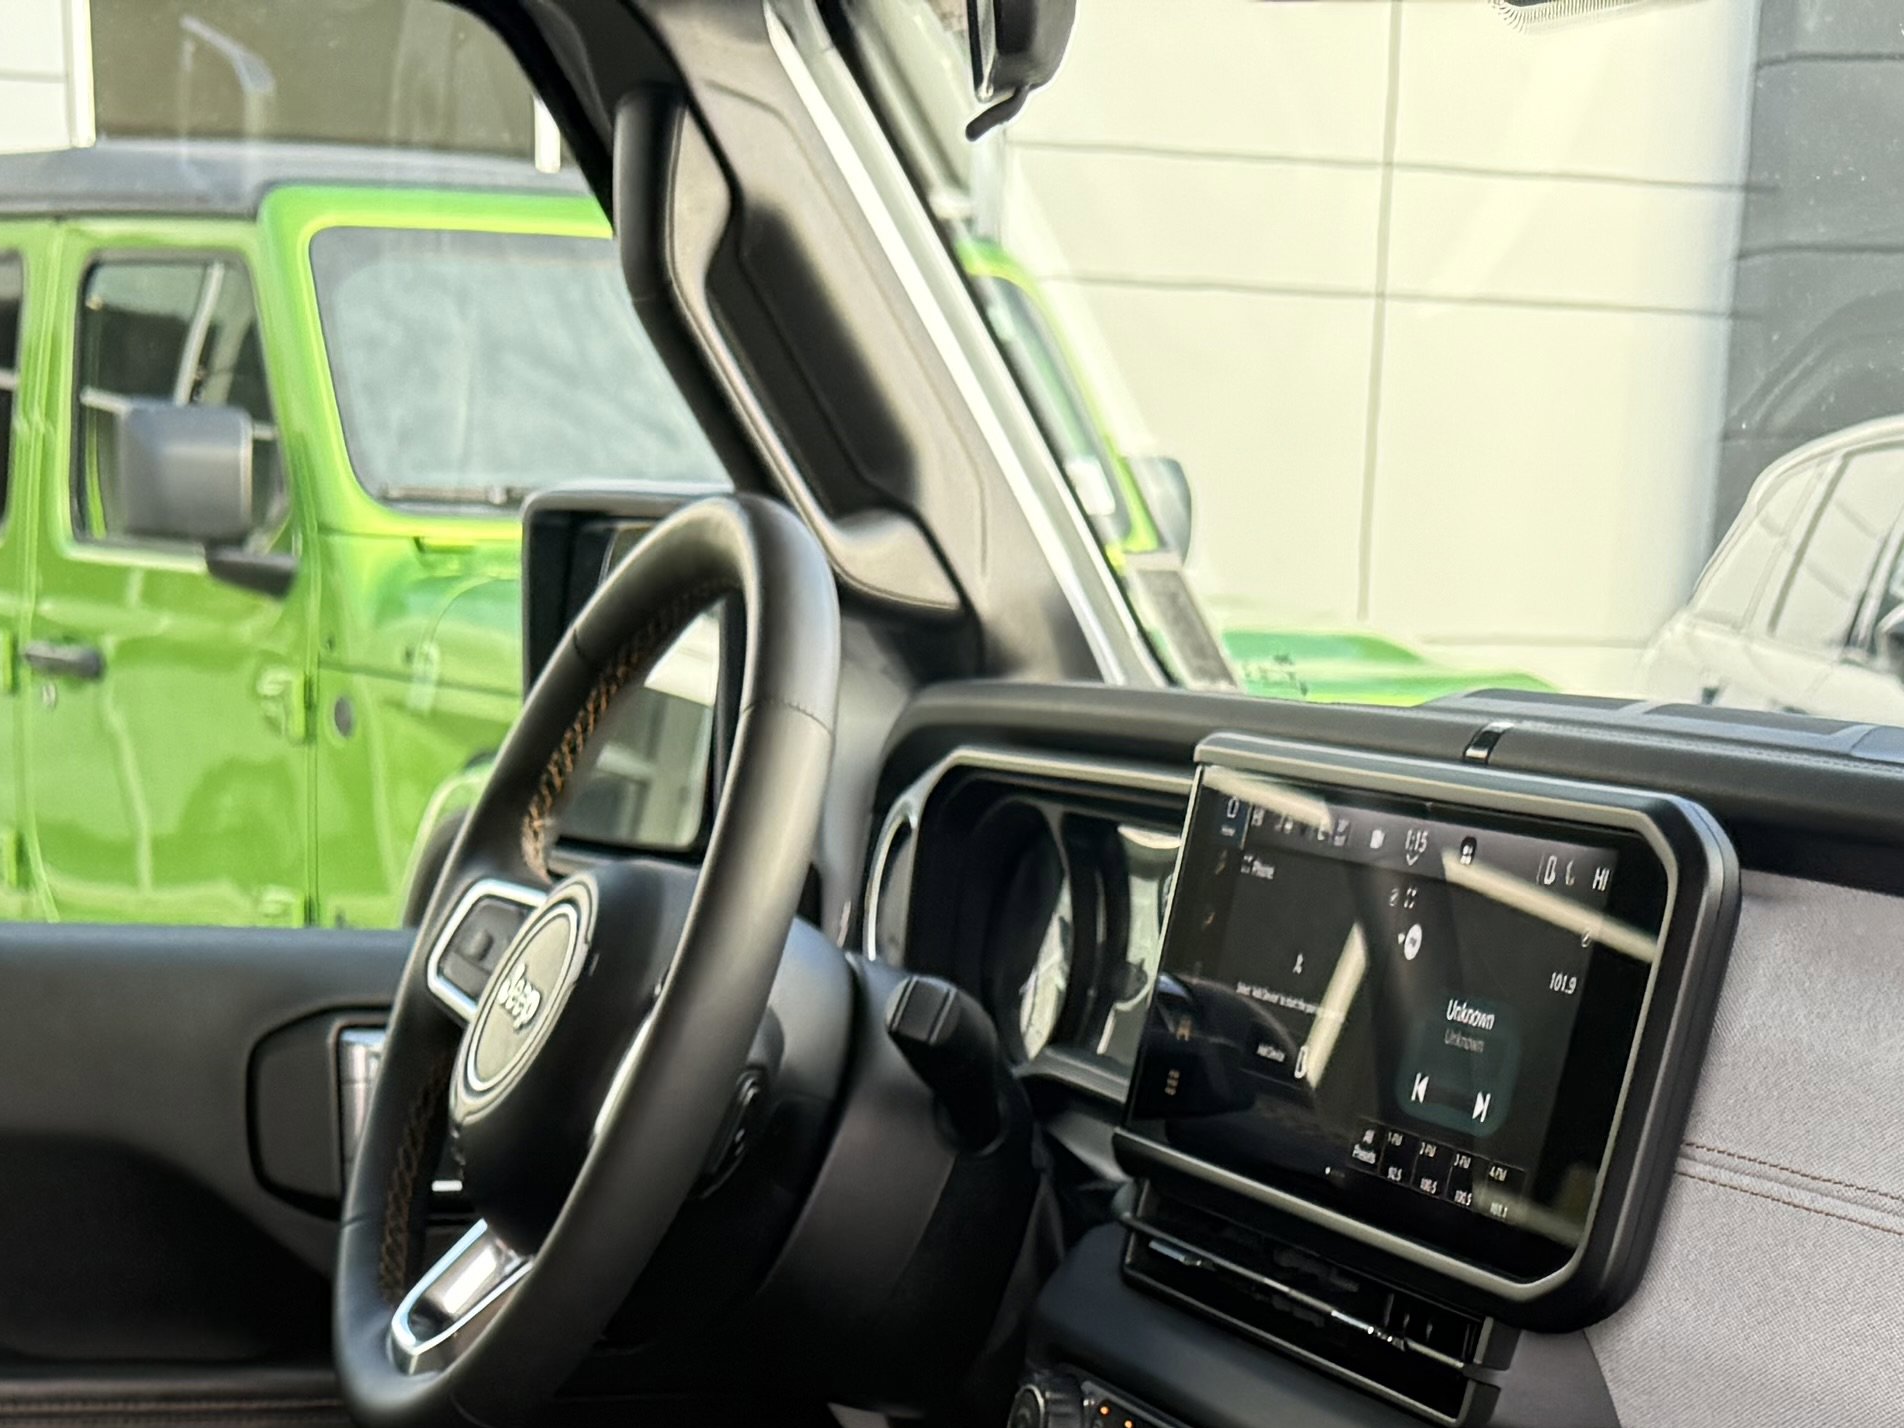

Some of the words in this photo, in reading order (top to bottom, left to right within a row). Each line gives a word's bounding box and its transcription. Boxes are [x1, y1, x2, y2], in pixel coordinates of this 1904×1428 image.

[1405, 829, 1429, 853] 1:15
[1592, 866, 1610, 891] HI
[496, 960, 541, 1030] Jeep
[1549, 971, 1577, 995] 101.9
[1446, 998, 1495, 1031] Unknown
